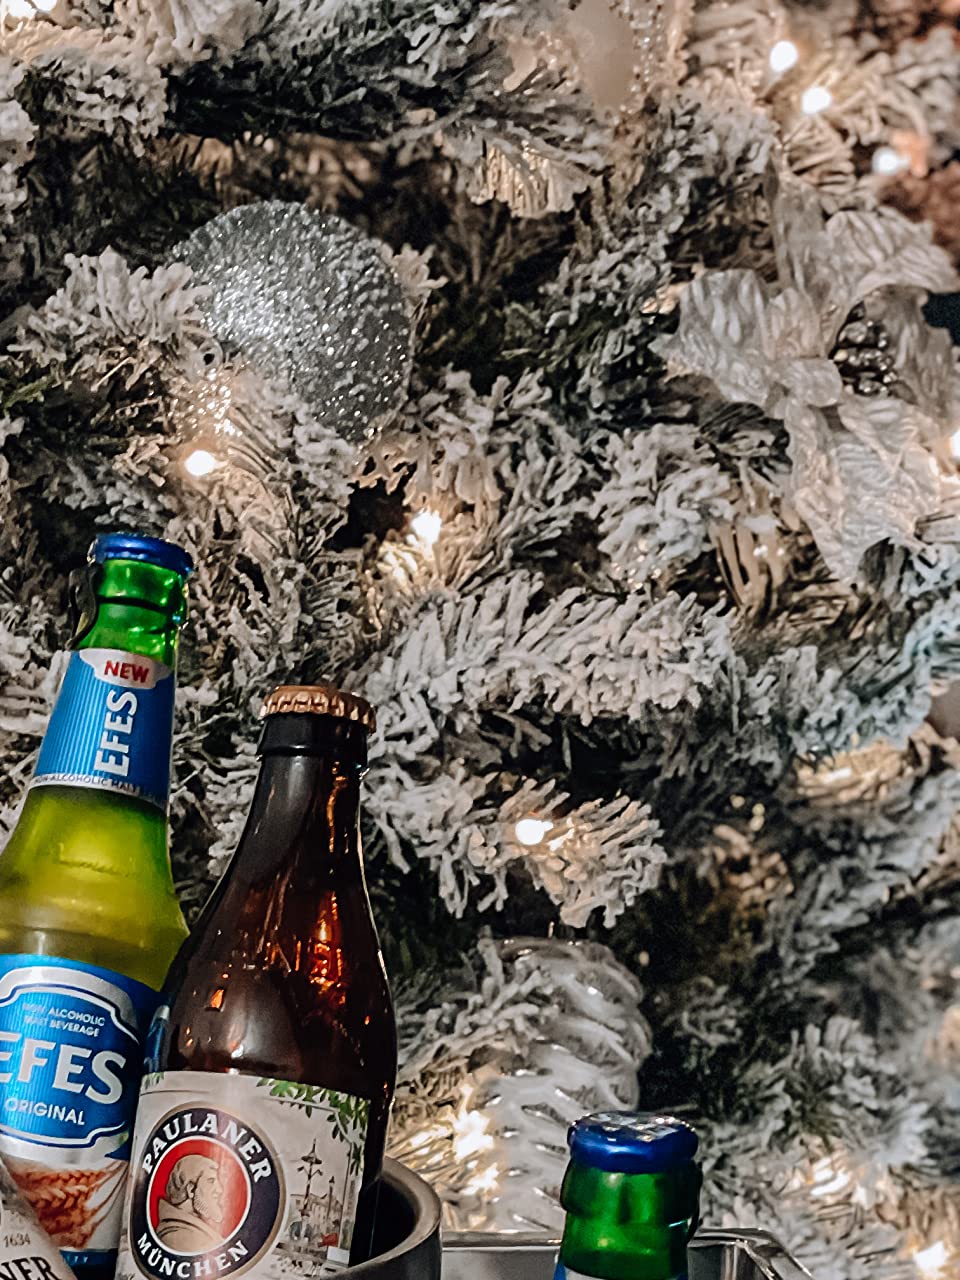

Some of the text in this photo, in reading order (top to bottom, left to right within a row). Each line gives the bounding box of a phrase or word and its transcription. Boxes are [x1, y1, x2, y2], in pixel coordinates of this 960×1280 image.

[104, 660, 150, 683] NEW
[93, 689, 138, 777] EFES
[48, 1007, 106, 1026] ALCOHOLIC
[49, 1019, 100, 1037] BEVERAGE
[3, 1096, 85, 1126] ORIGINAL
[141, 1113, 272, 1184] PAULANER
[137, 1232, 249, 1278] MÜNCHEN
